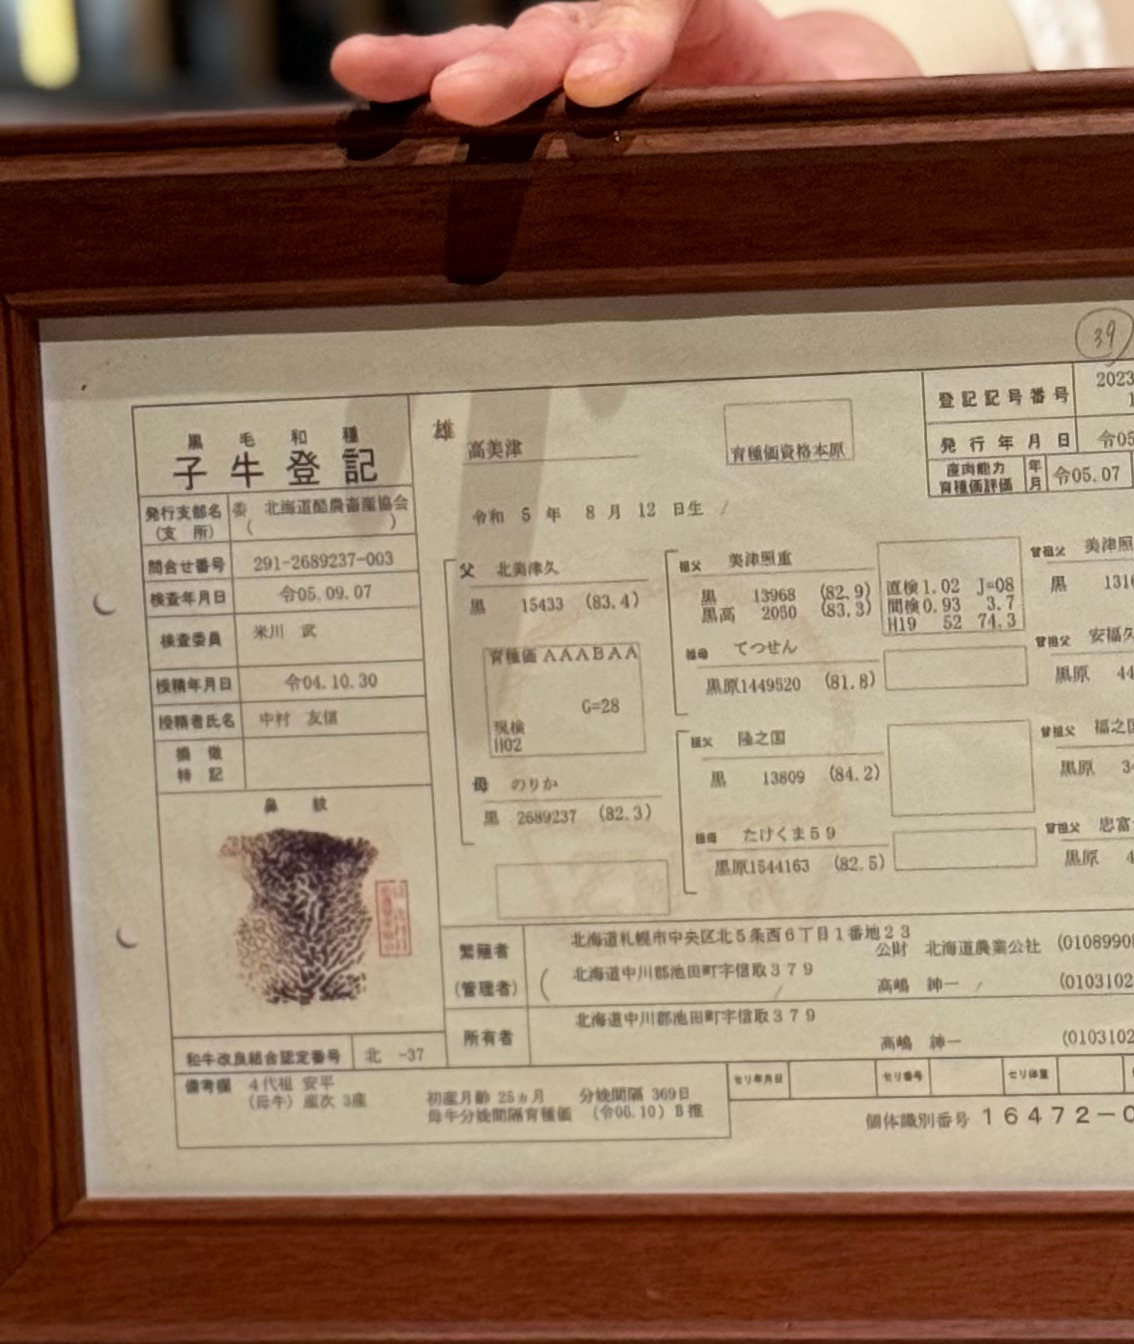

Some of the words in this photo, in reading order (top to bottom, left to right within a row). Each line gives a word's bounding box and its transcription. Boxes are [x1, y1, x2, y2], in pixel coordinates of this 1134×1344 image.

[938, 385, 1070, 409] 登記記号番号
[433, 418, 456, 441] 雄
[939, 432, 1071, 454] 発行年月日
[172, 448, 379, 491] 子牛登記
[1053, 465, 1121, 486] 令05.07
[145, 503, 223, 523] 発行支部名
[147, 557, 226, 576] 問合せ番号
[252, 551, 395, 573] 291-2689237-003
[459, 561, 476, 579] 父
[149, 590, 227, 608] 検査年月日
[279, 583, 373, 604] 令05.09.07
[986, 594, 1015, 612] 3.7
[520, 595, 565, 614] 15433
[942, 614, 963, 631] 52
[977, 612, 1017, 629] 74.3
[160, 630, 223, 650] 検査委員
[734, 639, 798, 656] てつせん
[284, 672, 378, 693] 令04.10.30
[511, 776, 559, 793] のりか
[762, 769, 806, 786] 13809
[463, 1029, 514, 1047] 所有者
